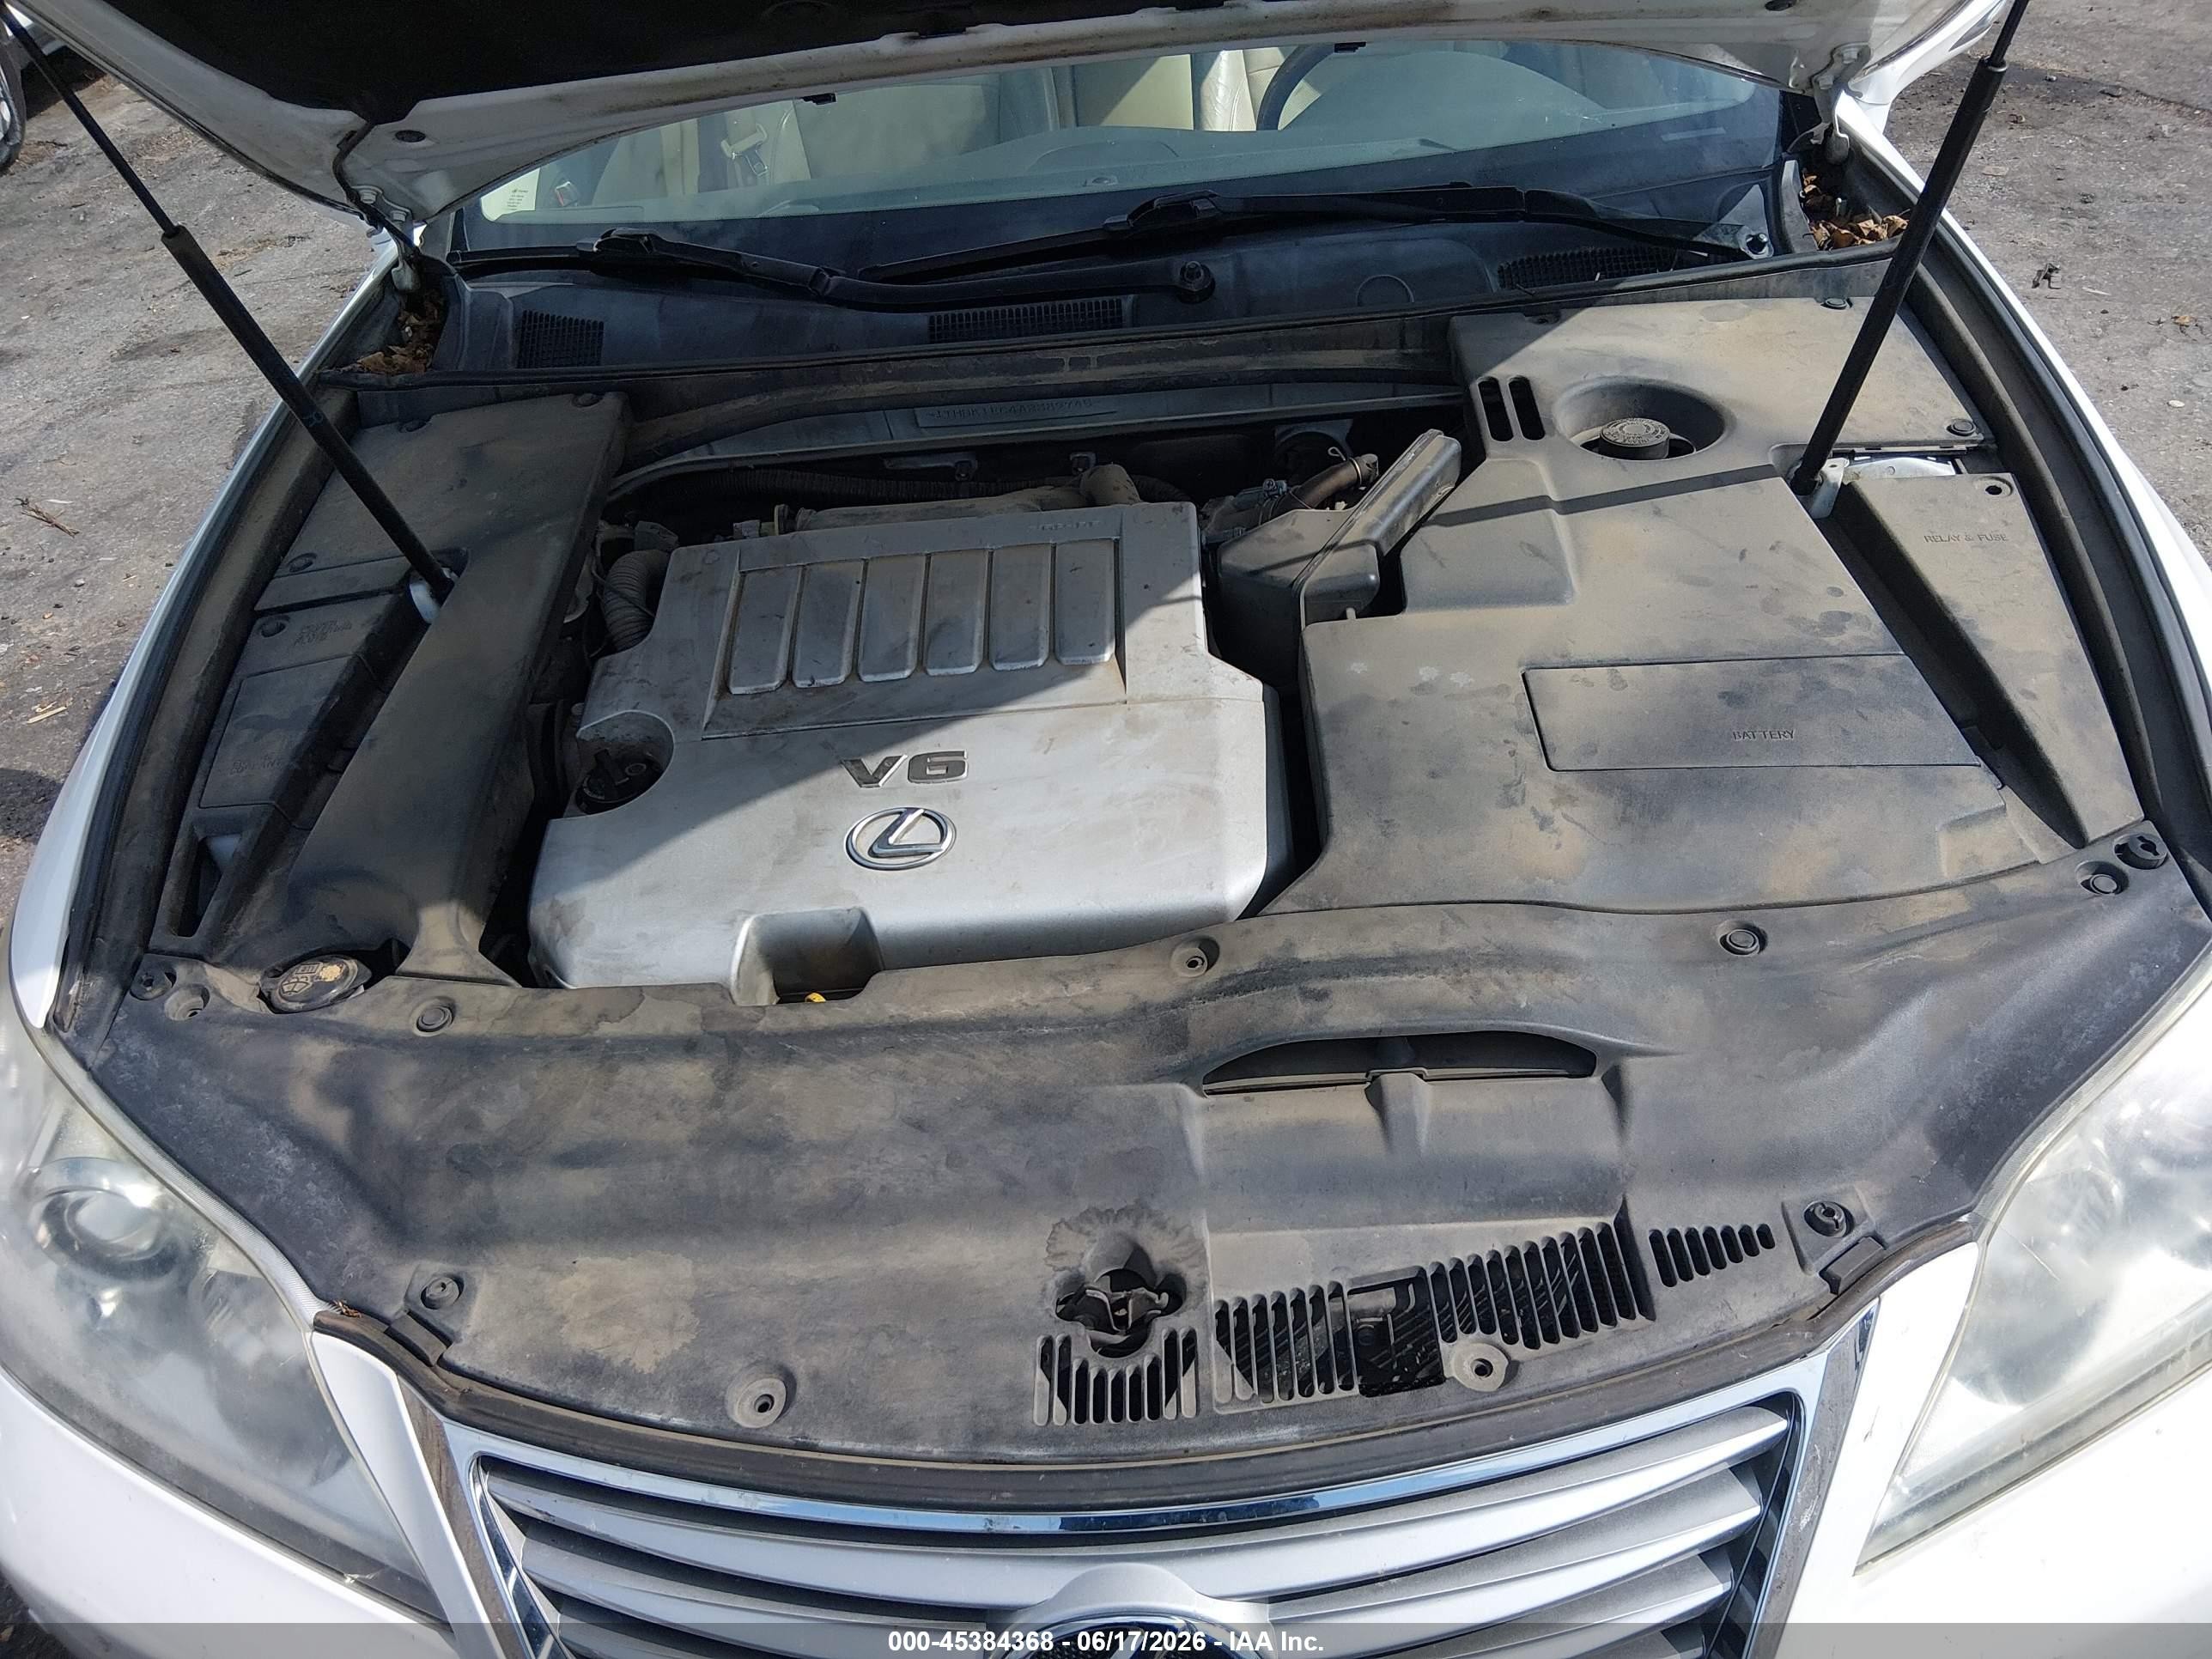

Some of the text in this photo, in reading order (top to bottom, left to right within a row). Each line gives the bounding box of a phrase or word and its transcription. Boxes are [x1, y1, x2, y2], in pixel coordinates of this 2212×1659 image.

[1923, 532, 2008, 543] RELAY & FUSE
[1732, 729, 1795, 740] BATTERY
[840, 750, 969, 788] V6
